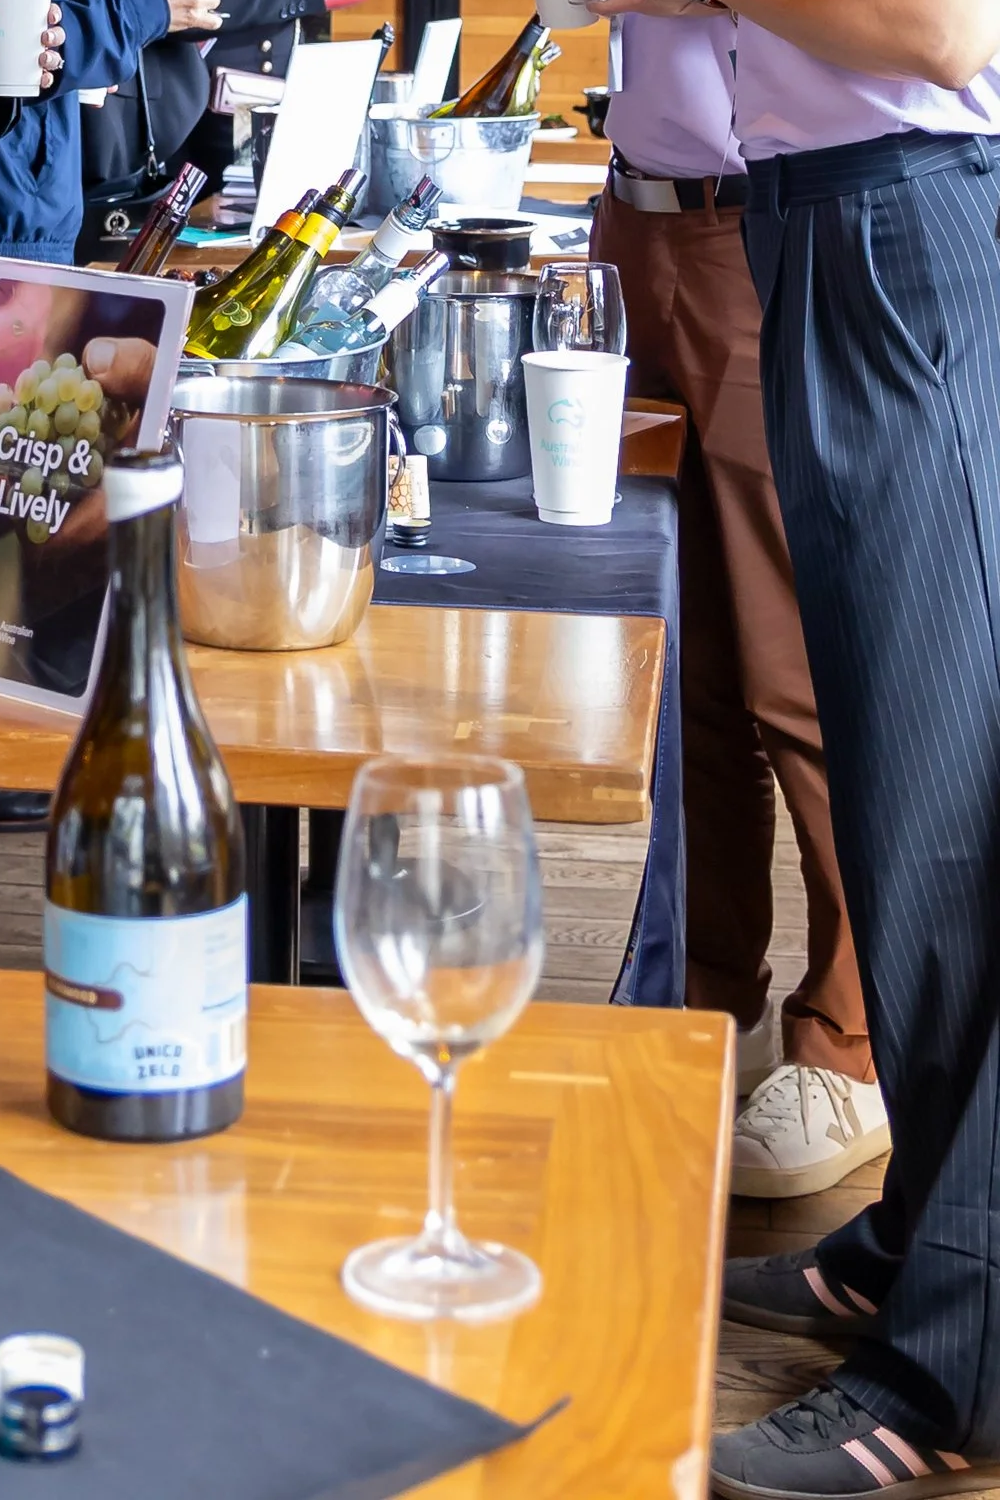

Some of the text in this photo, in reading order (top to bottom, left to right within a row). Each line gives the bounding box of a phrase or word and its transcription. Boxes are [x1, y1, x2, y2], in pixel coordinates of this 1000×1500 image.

[68, 439, 92, 476] &
[0, 620, 34, 638] Australian
[0, 631, 16, 645] Wine
[136, 1064, 180, 1080] ZELO
